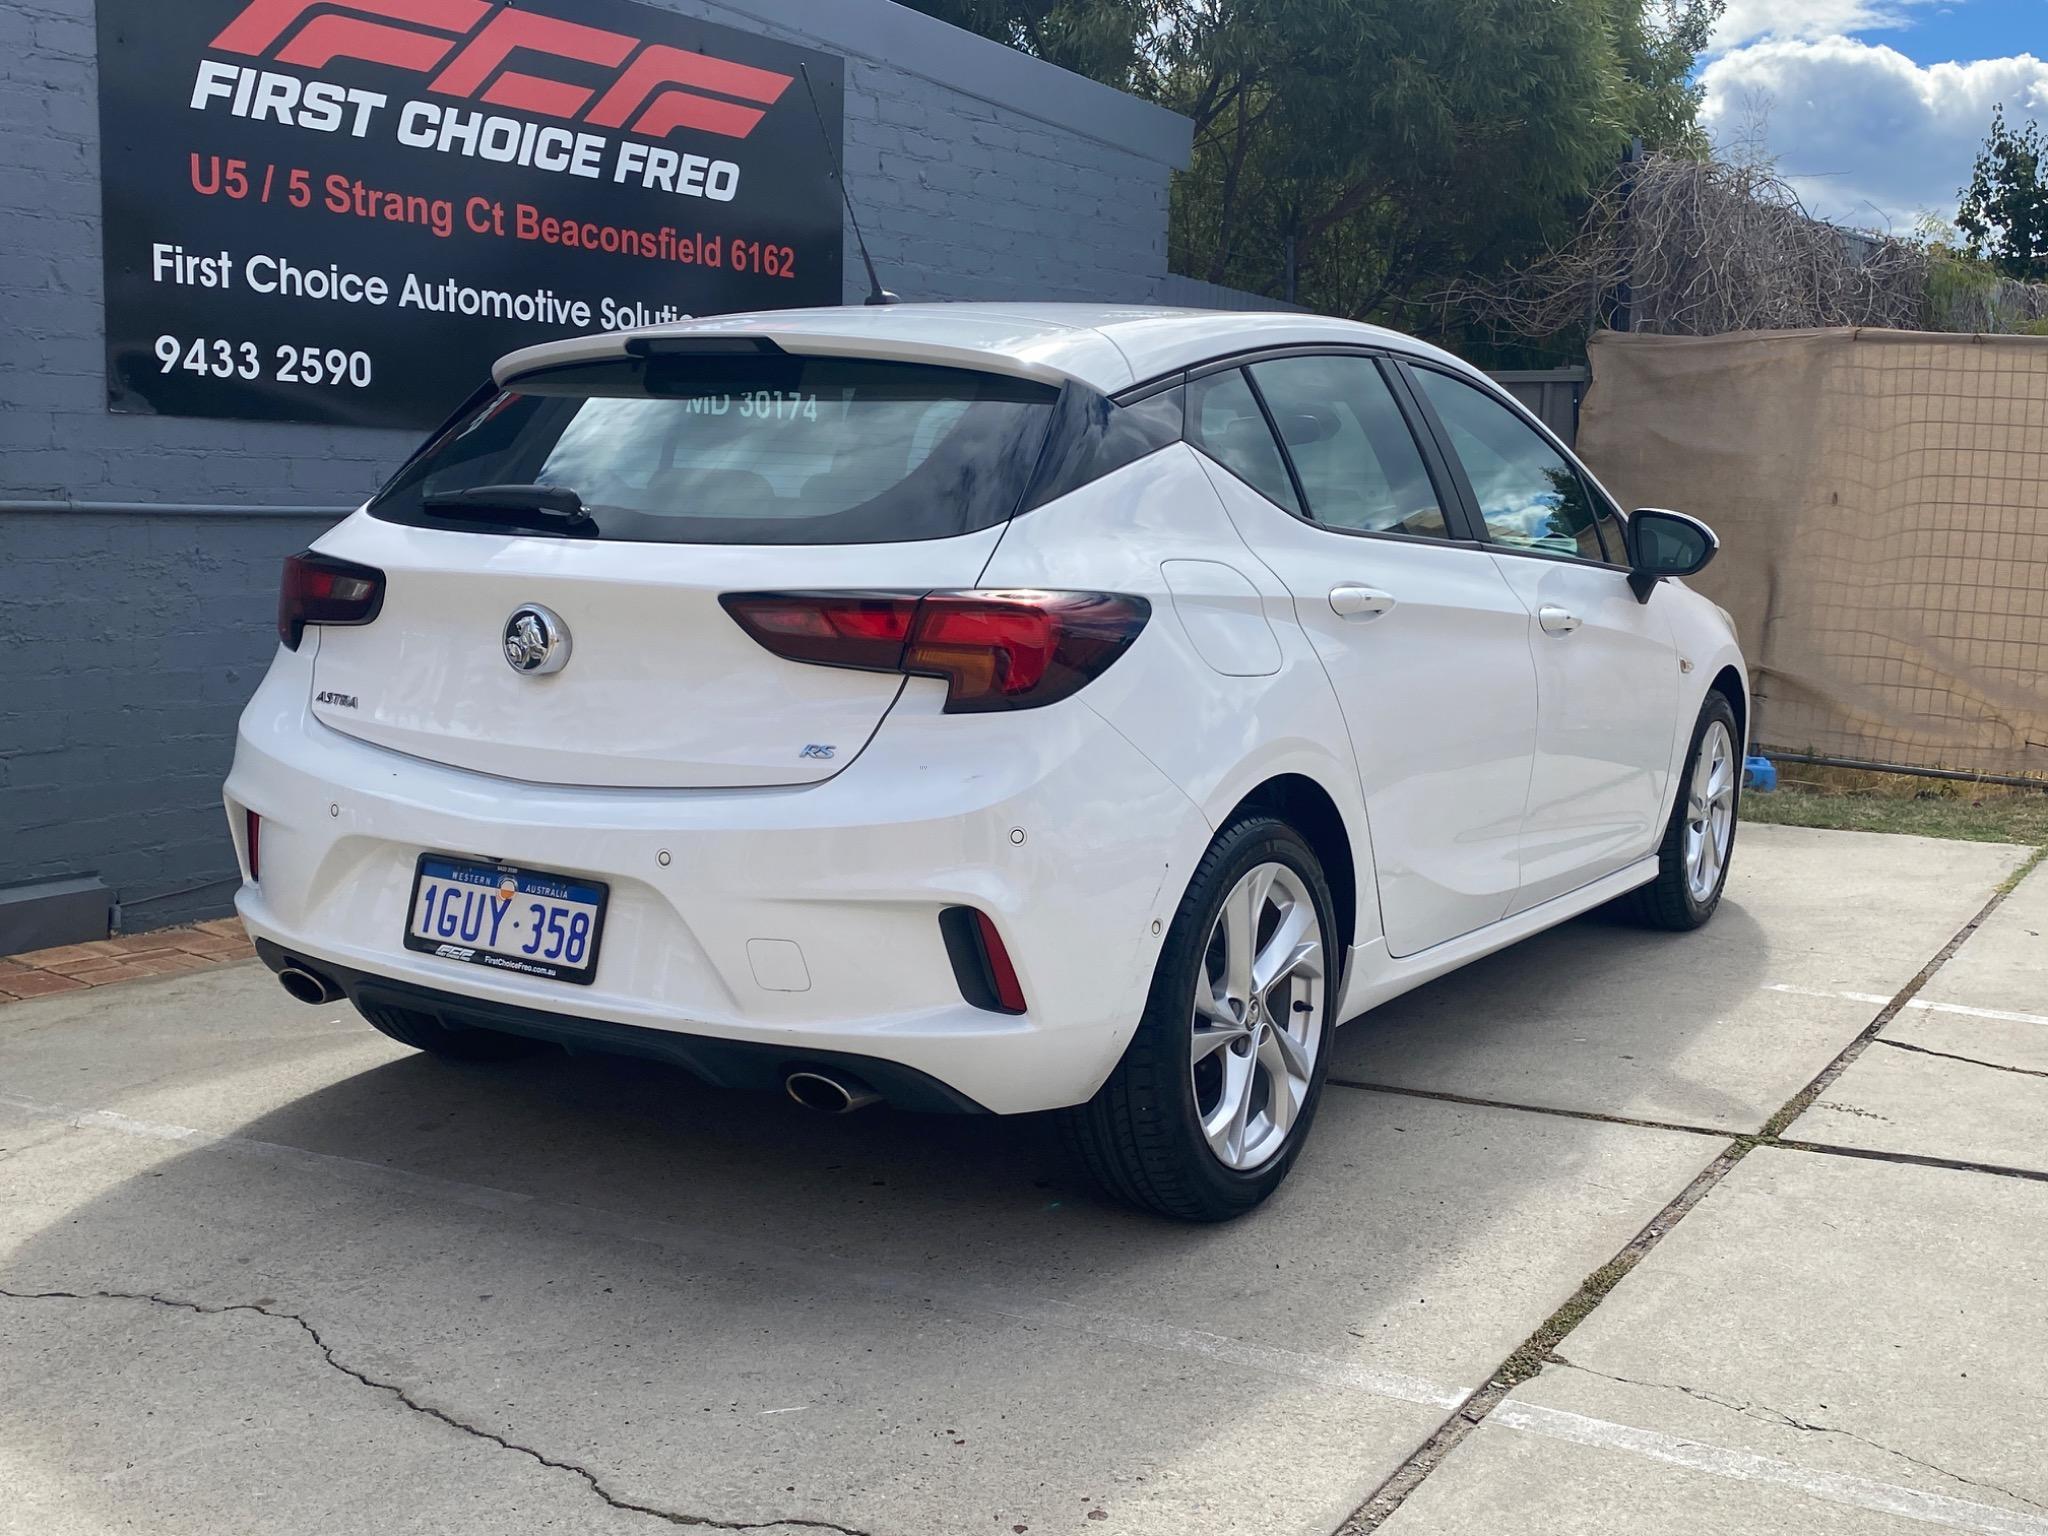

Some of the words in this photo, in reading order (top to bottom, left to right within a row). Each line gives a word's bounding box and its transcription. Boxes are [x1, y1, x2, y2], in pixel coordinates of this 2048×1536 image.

[190, 59, 388, 138] FIRST
[397, 100, 607, 179] CHOICE
[613, 141, 741, 202] FREO
[190, 152, 249, 199] U5
[288, 168, 312, 208] 5
[325, 174, 454, 238] Strang
[465, 196, 505, 236] Ct
[516, 203, 722, 268] Beaconsfield
[731, 239, 796, 279] 6162
[153, 243, 233, 289] First
[245, 254, 389, 305] Choice
[399, 273, 591, 328] Automotive
[155, 334, 261, 381] 9433
[275, 344, 373, 388] 2590
[739, 391, 818, 423] 30174
[452, 871, 492, 887] WESTERN
[524, 883, 569, 899] AUSTRALIA
